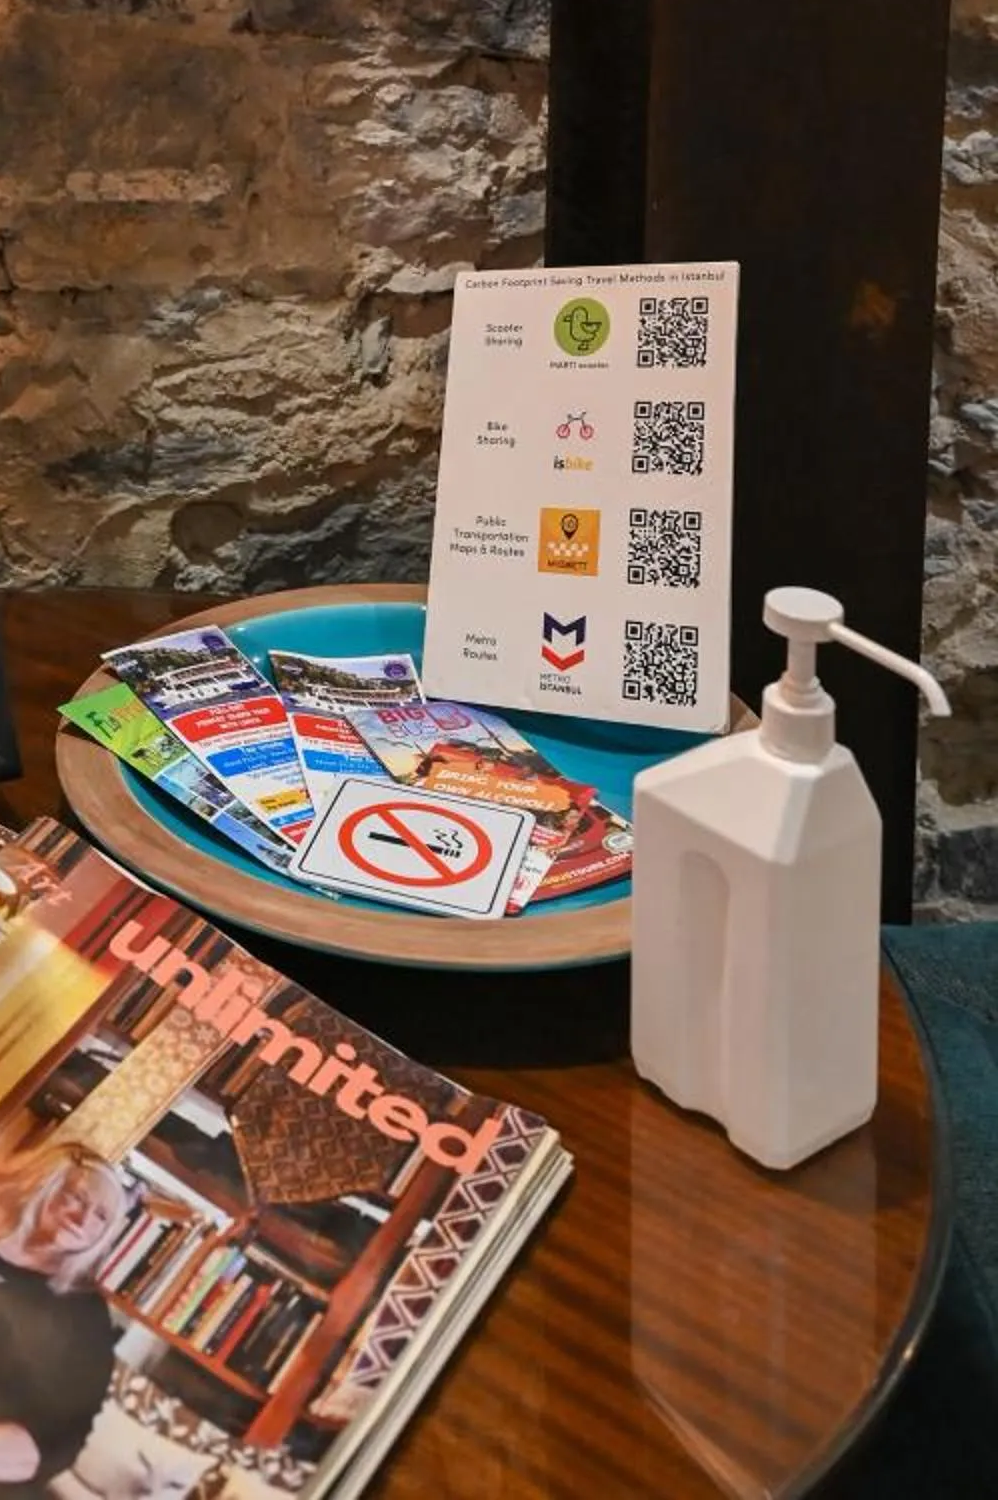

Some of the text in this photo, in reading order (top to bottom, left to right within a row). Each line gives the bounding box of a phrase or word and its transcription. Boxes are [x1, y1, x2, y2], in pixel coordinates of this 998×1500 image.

[485, 322, 524, 333] Scooter
[485, 336, 523, 348] Sharing
[487, 421, 508, 432] Bike
[477, 435, 516, 448] Sharing
[475, 515, 507, 527] Public
[454, 528, 530, 543] Transportation
[449, 543, 478, 556] Maps
[490, 546, 525, 557] Routes
[465, 633, 497, 646] Metro
[462, 647, 498, 661] Routes
[539, 673, 571, 684] METRO
[377, 706, 427, 725] BIG
[388, 720, 439, 738] BUS
[433, 782, 472, 797] OWN
[5, 862, 73, 904] Art
[108, 919, 503, 1176] unlimited
